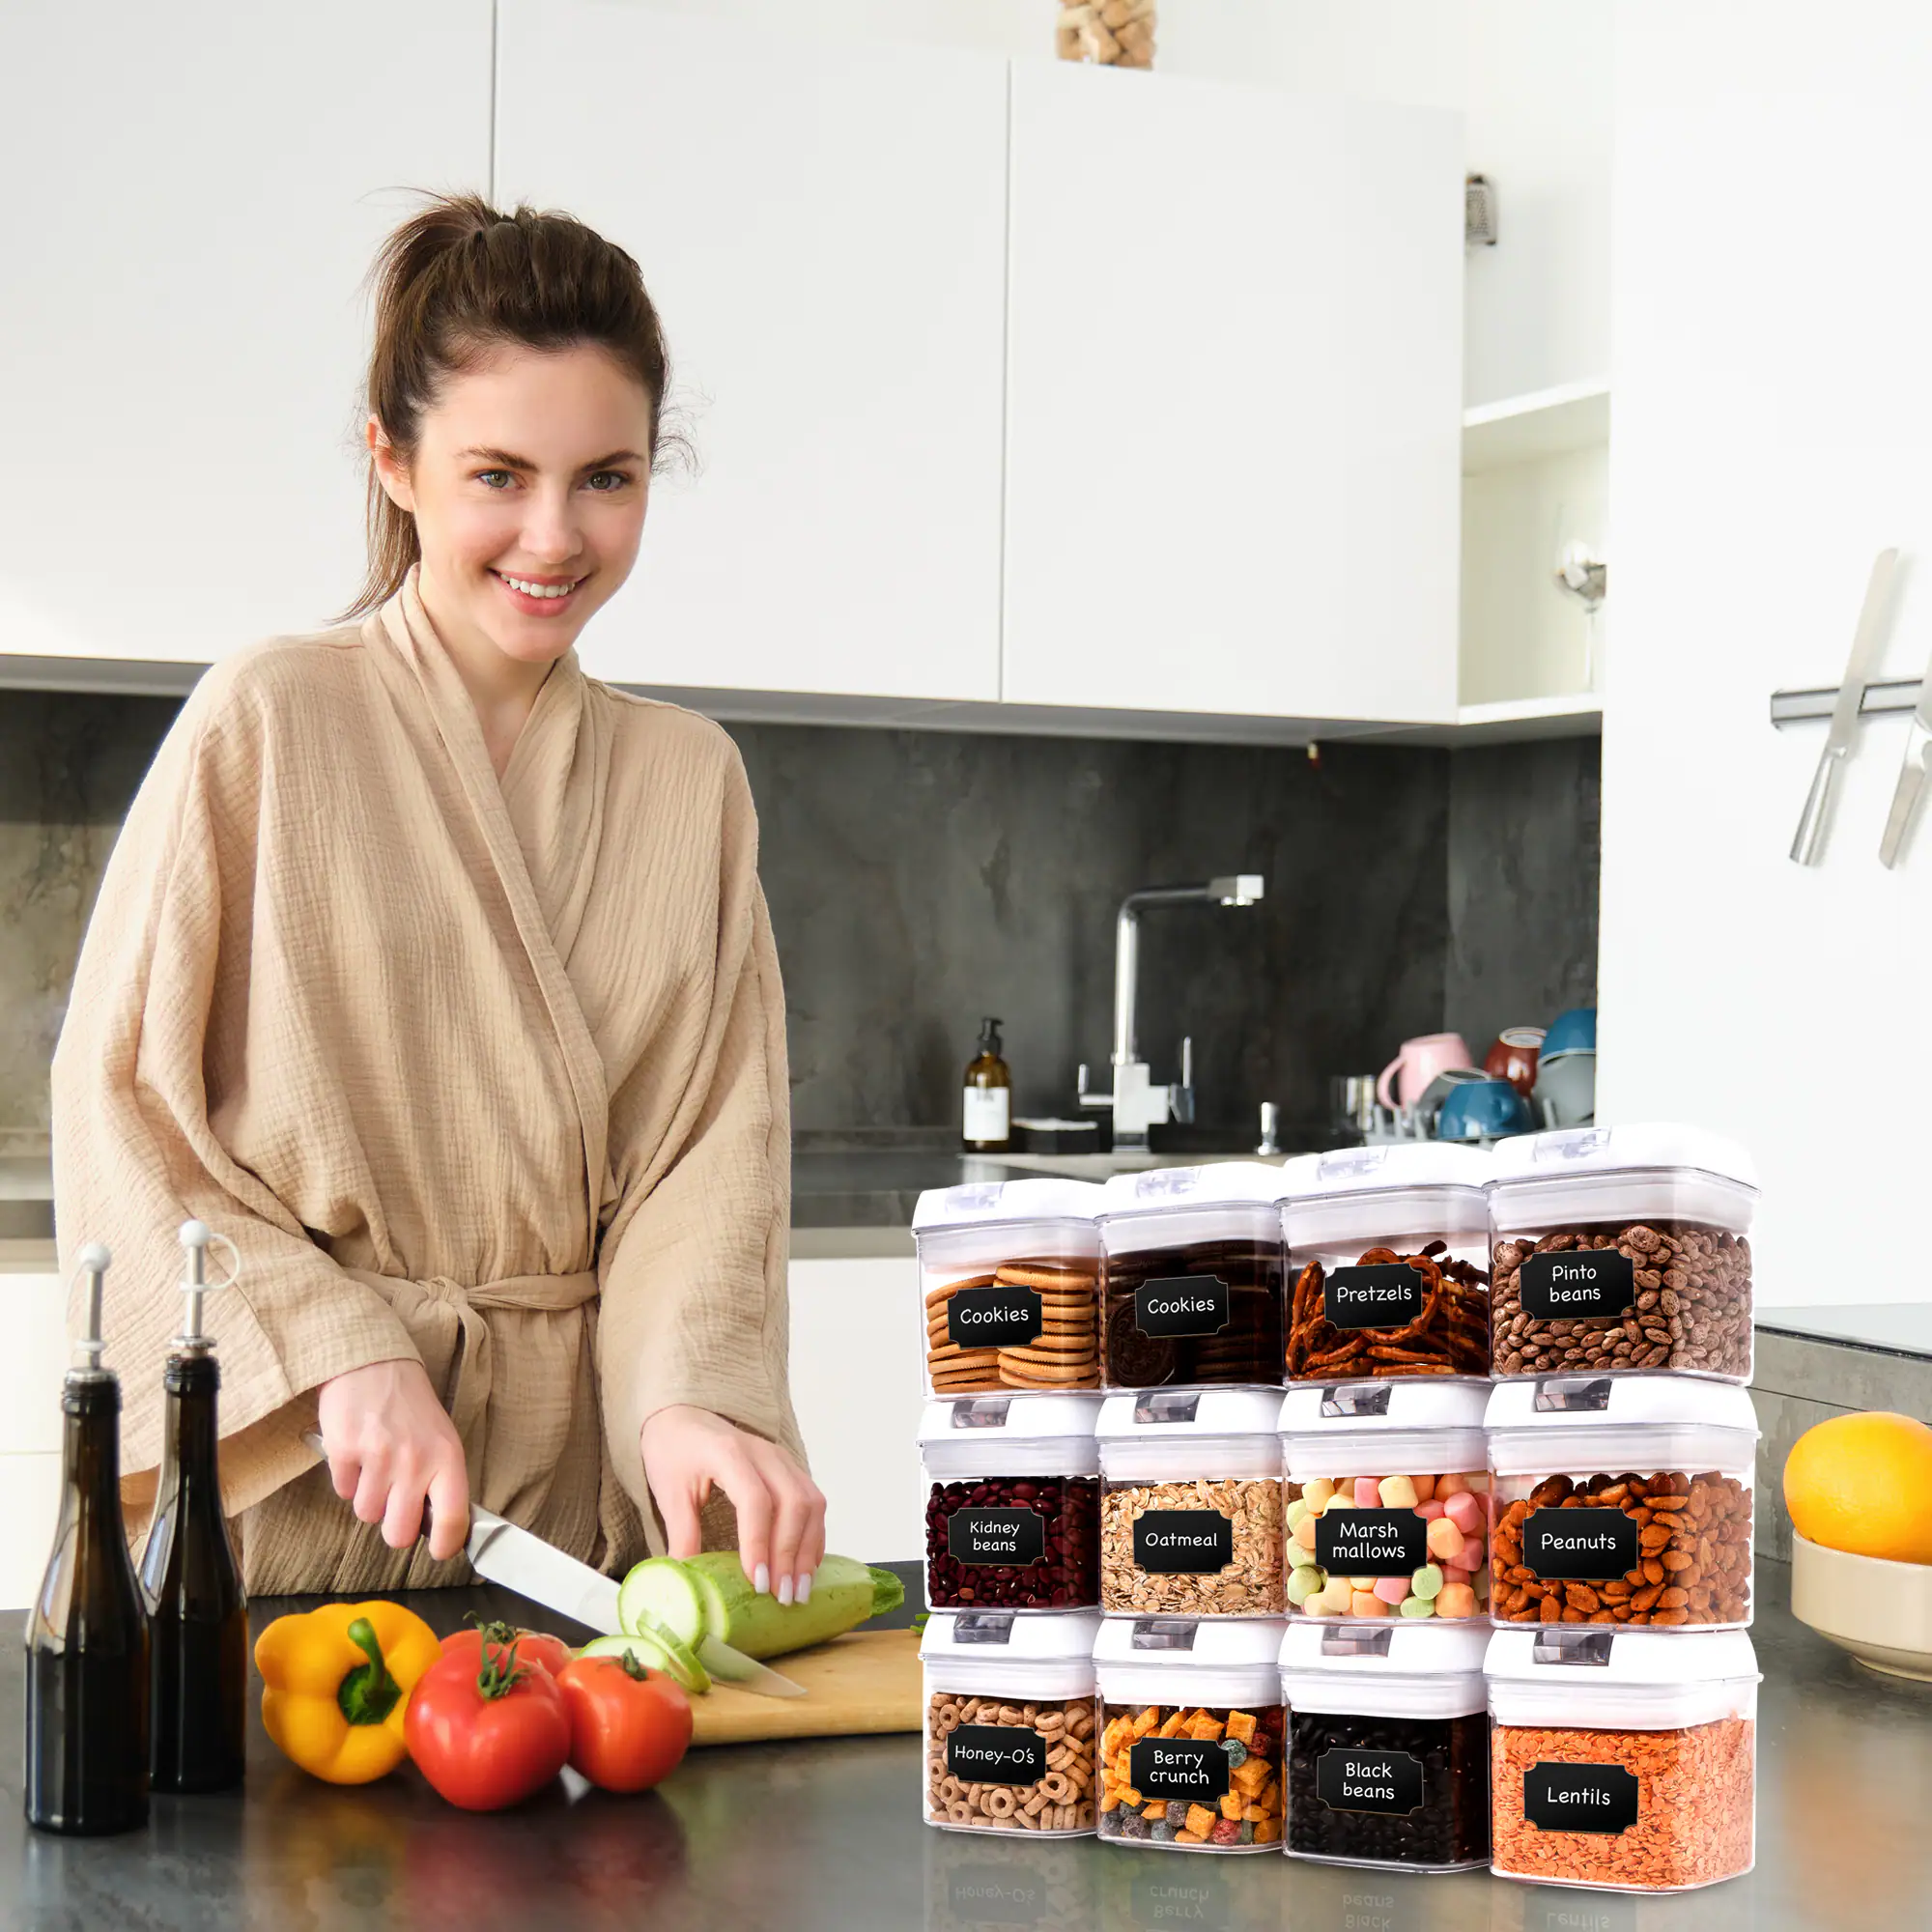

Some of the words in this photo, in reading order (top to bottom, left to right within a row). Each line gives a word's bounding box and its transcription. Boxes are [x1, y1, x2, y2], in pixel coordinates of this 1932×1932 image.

[1551, 1264, 1597, 1282] Pinto
[1336, 1284, 1412, 1303] Pretzels
[1549, 1287, 1602, 1303] beans
[1147, 1295, 1215, 1315] Cookies
[959, 1305, 1030, 1324] Cookies
[970, 1520, 1020, 1538] Kidney
[1339, 1521, 1399, 1539] Marsh
[973, 1537, 1017, 1552] beans
[1145, 1532, 1218, 1548] Oatmeal
[1541, 1532, 1616, 1550] Peanuts
[1332, 1542, 1406, 1559] mallows
[954, 1745, 1035, 1766] Honey-O's
[1153, 1749, 1205, 1770] Berry
[1150, 1769, 1209, 1785] crunch
[1345, 1761, 1393, 1778] Black
[1343, 1780, 1395, 1800] beans
[1547, 1786, 1611, 1806] Lentils
